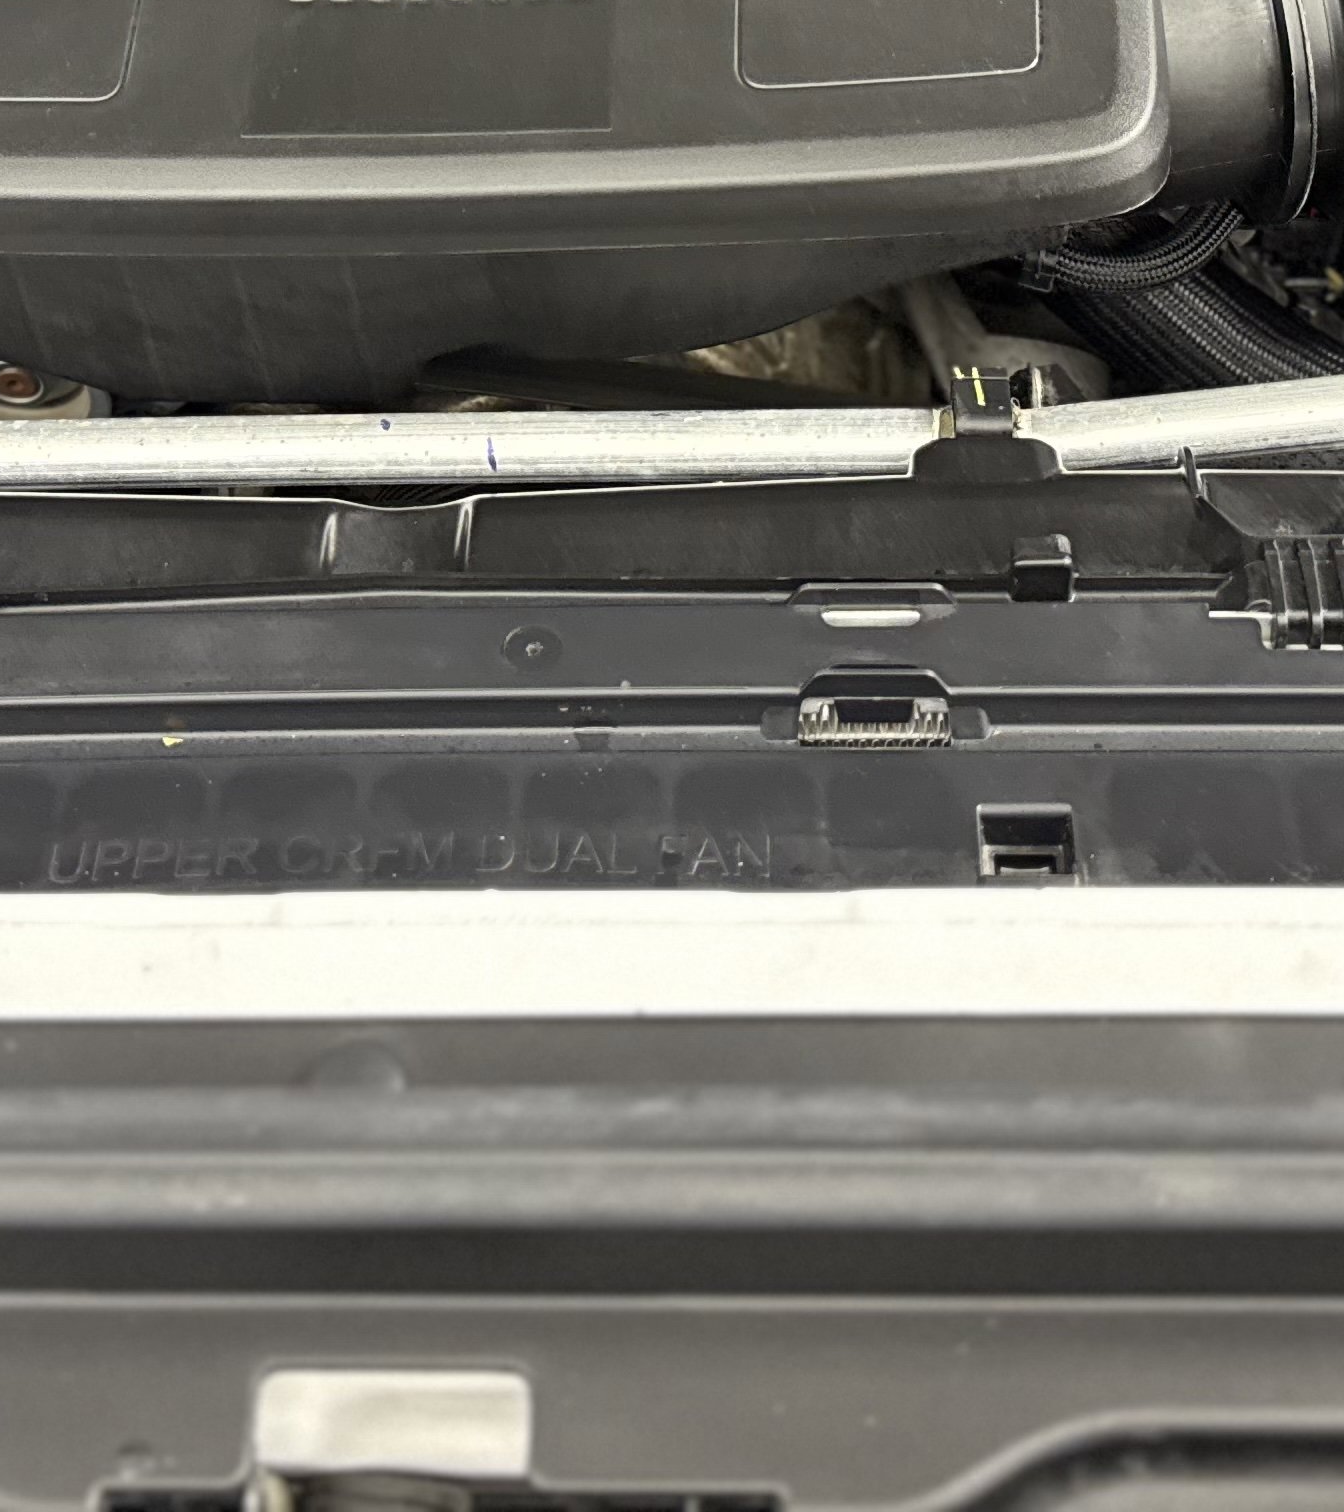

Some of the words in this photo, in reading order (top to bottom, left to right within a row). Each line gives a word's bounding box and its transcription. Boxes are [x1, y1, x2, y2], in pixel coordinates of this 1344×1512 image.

[47, 836, 260, 885] UPPER
[474, 830, 640, 876] DUAL
[655, 832, 772, 878] FAN
